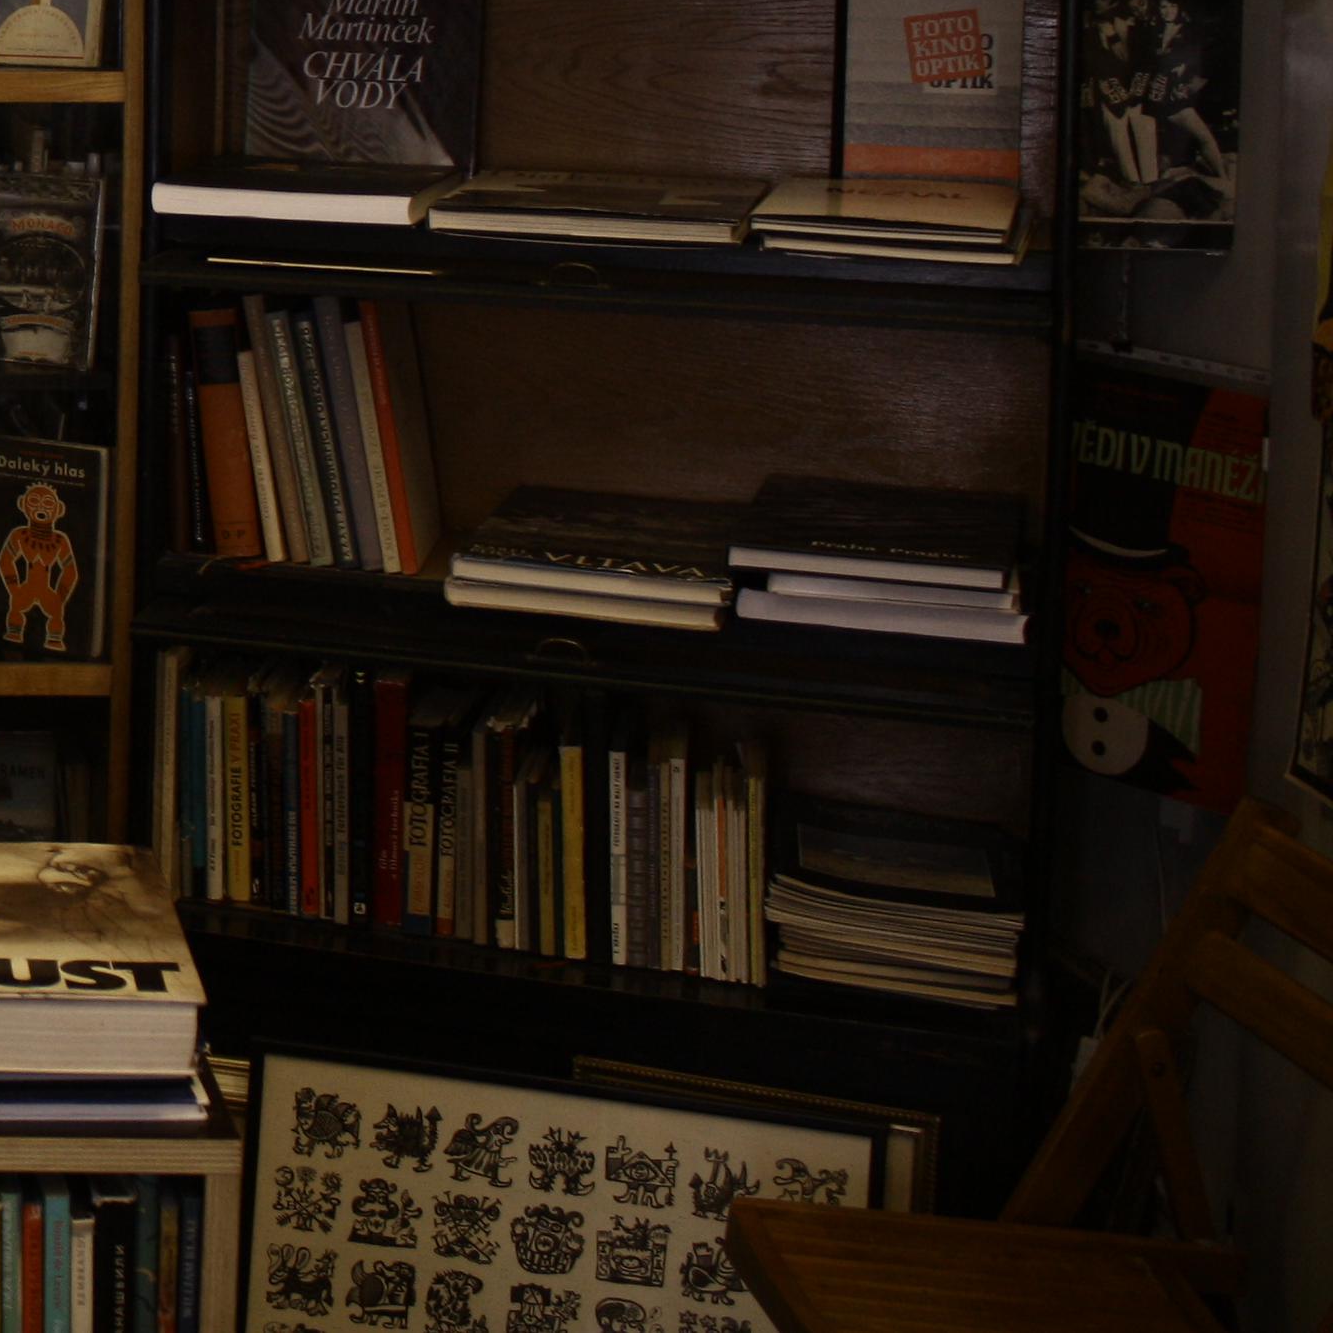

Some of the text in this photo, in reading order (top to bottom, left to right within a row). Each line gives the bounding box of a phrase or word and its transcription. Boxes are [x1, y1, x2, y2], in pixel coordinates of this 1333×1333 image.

[298, 12, 436, 45] Martinček
[910, 14, 975, 40] FOTO
[912, 34, 976, 59] KINO
[304, 48, 425, 84] CHVÁLA
[914, 54, 982, 78] OPTIK
[316, 80, 409, 109] VODY
[54, 462, 86, 479] hlas
[230, 766, 244, 849] FOTOGRAFIE
[409, 743, 431, 848] FOTOGRAFIA
